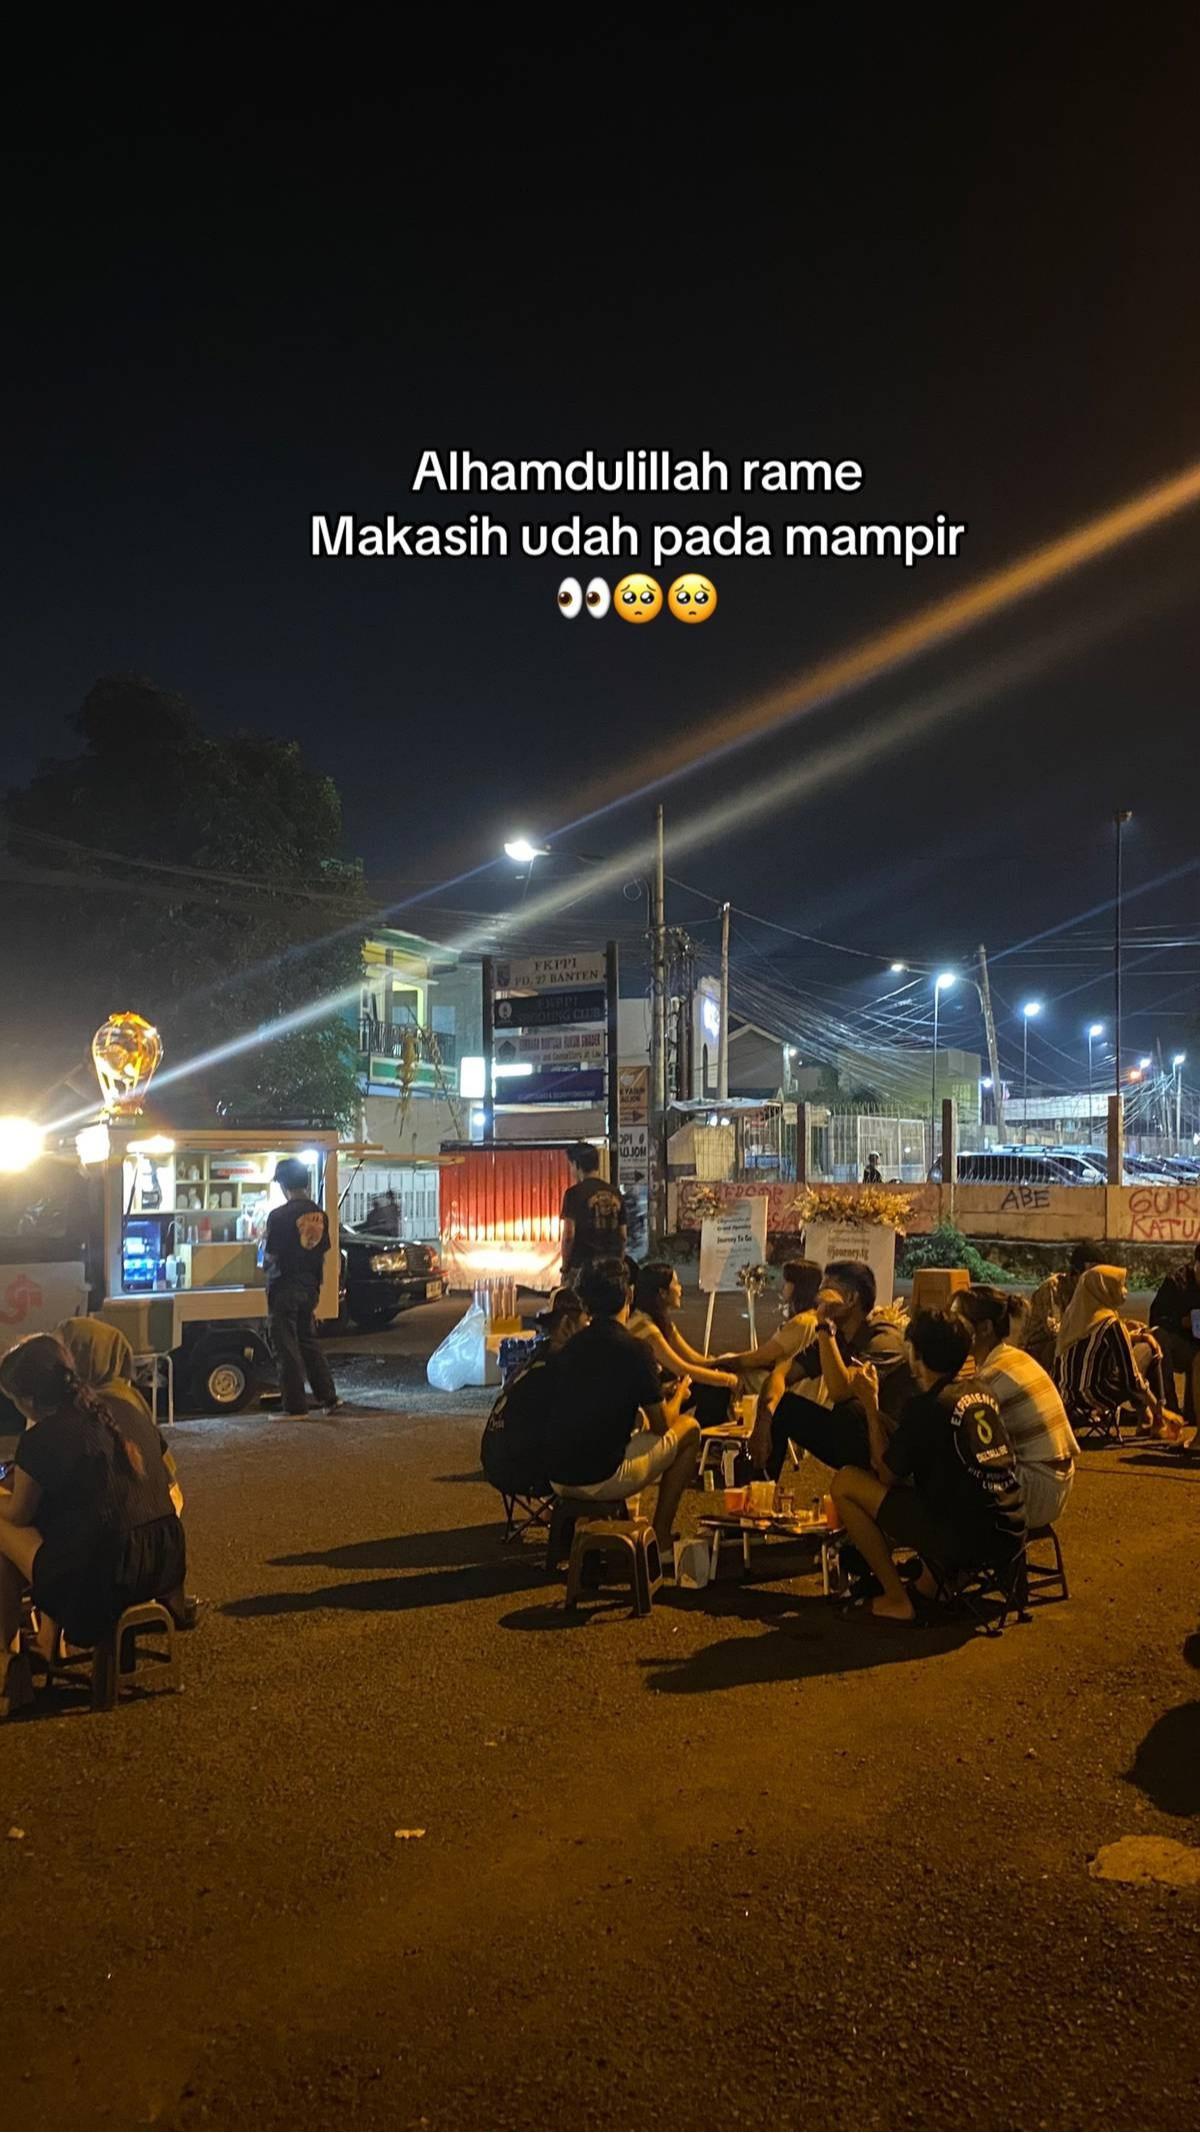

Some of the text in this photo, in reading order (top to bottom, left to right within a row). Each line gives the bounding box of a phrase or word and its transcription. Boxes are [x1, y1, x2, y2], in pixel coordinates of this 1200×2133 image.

[550, 970, 599, 983] BANTEN
[1001, 1186, 1049, 1210] ABE
[1129, 1188, 1200, 1214] GUR
